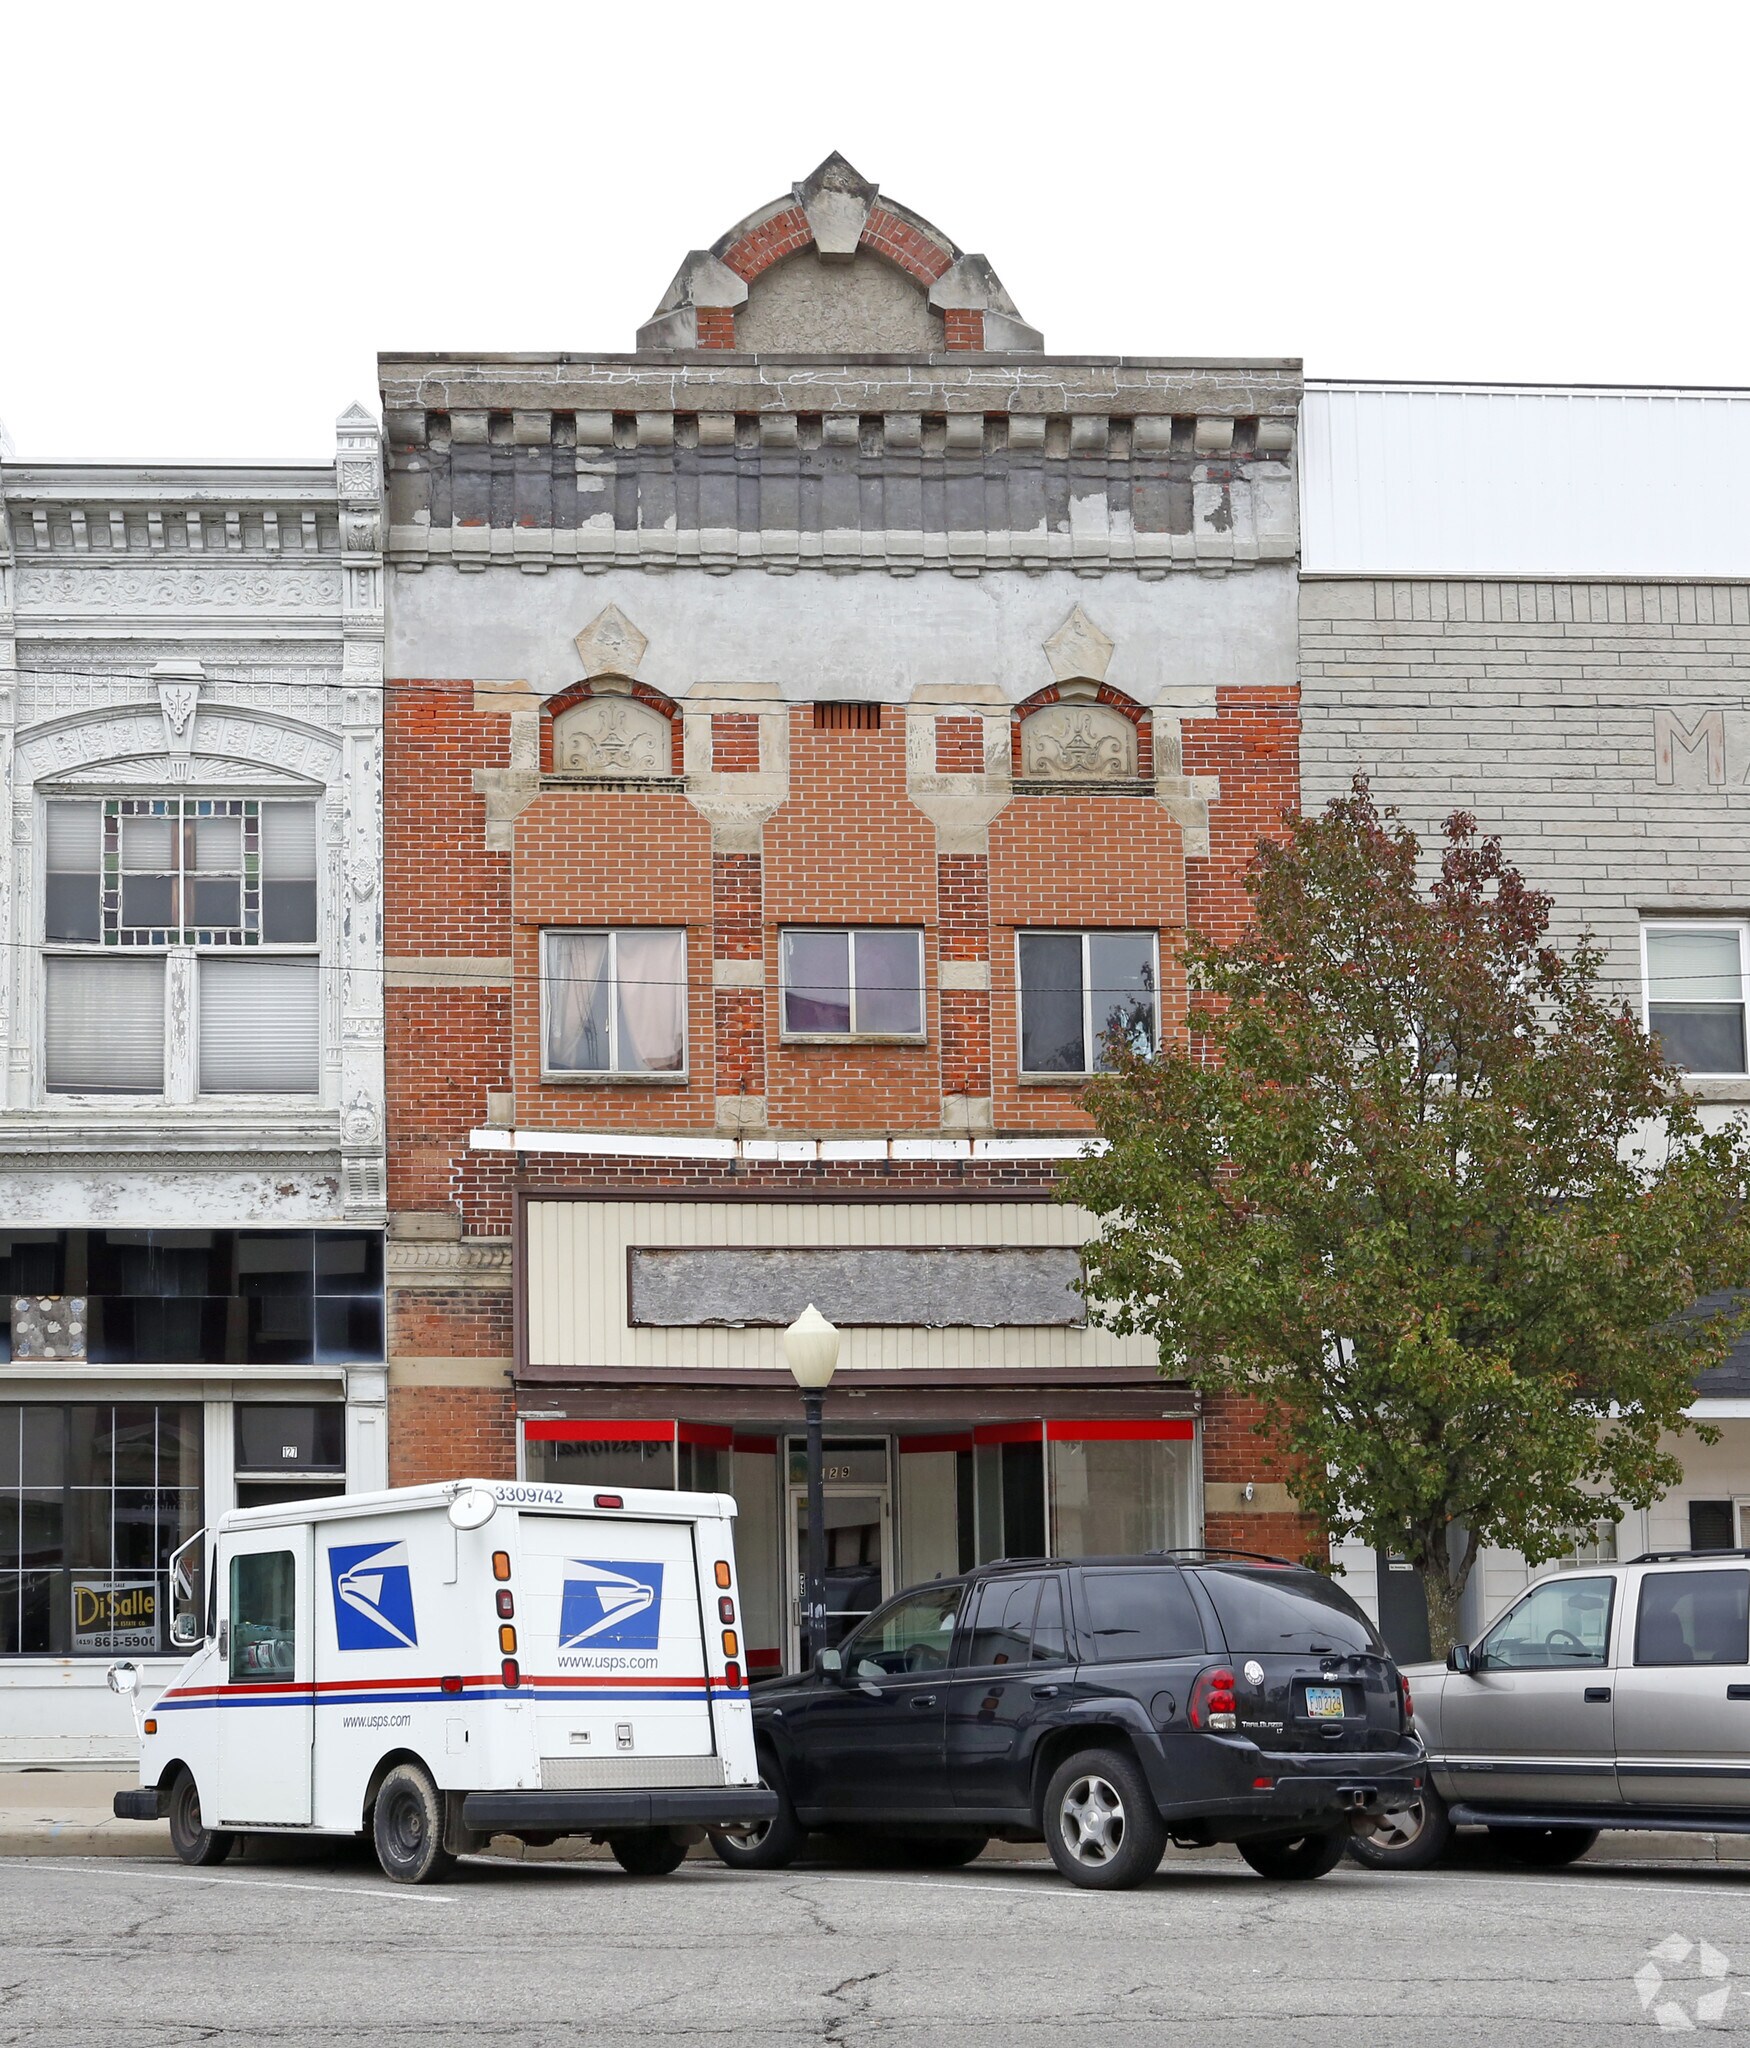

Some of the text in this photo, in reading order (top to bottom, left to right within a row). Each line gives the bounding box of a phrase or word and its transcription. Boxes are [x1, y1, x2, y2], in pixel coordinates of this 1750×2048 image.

[1653, 708, 1750, 786] M
[283, 1447, 296, 1458] 127
[822, 1467, 849, 1479] 29
[495, 1485, 564, 1504] 3309742
[74, 1587, 155, 1626] DiSalle
[76, 1638, 93, 1646] (419)
[557, 1655, 658, 1672] www.usps.com
[343, 1714, 411, 1730] www.usps.com
